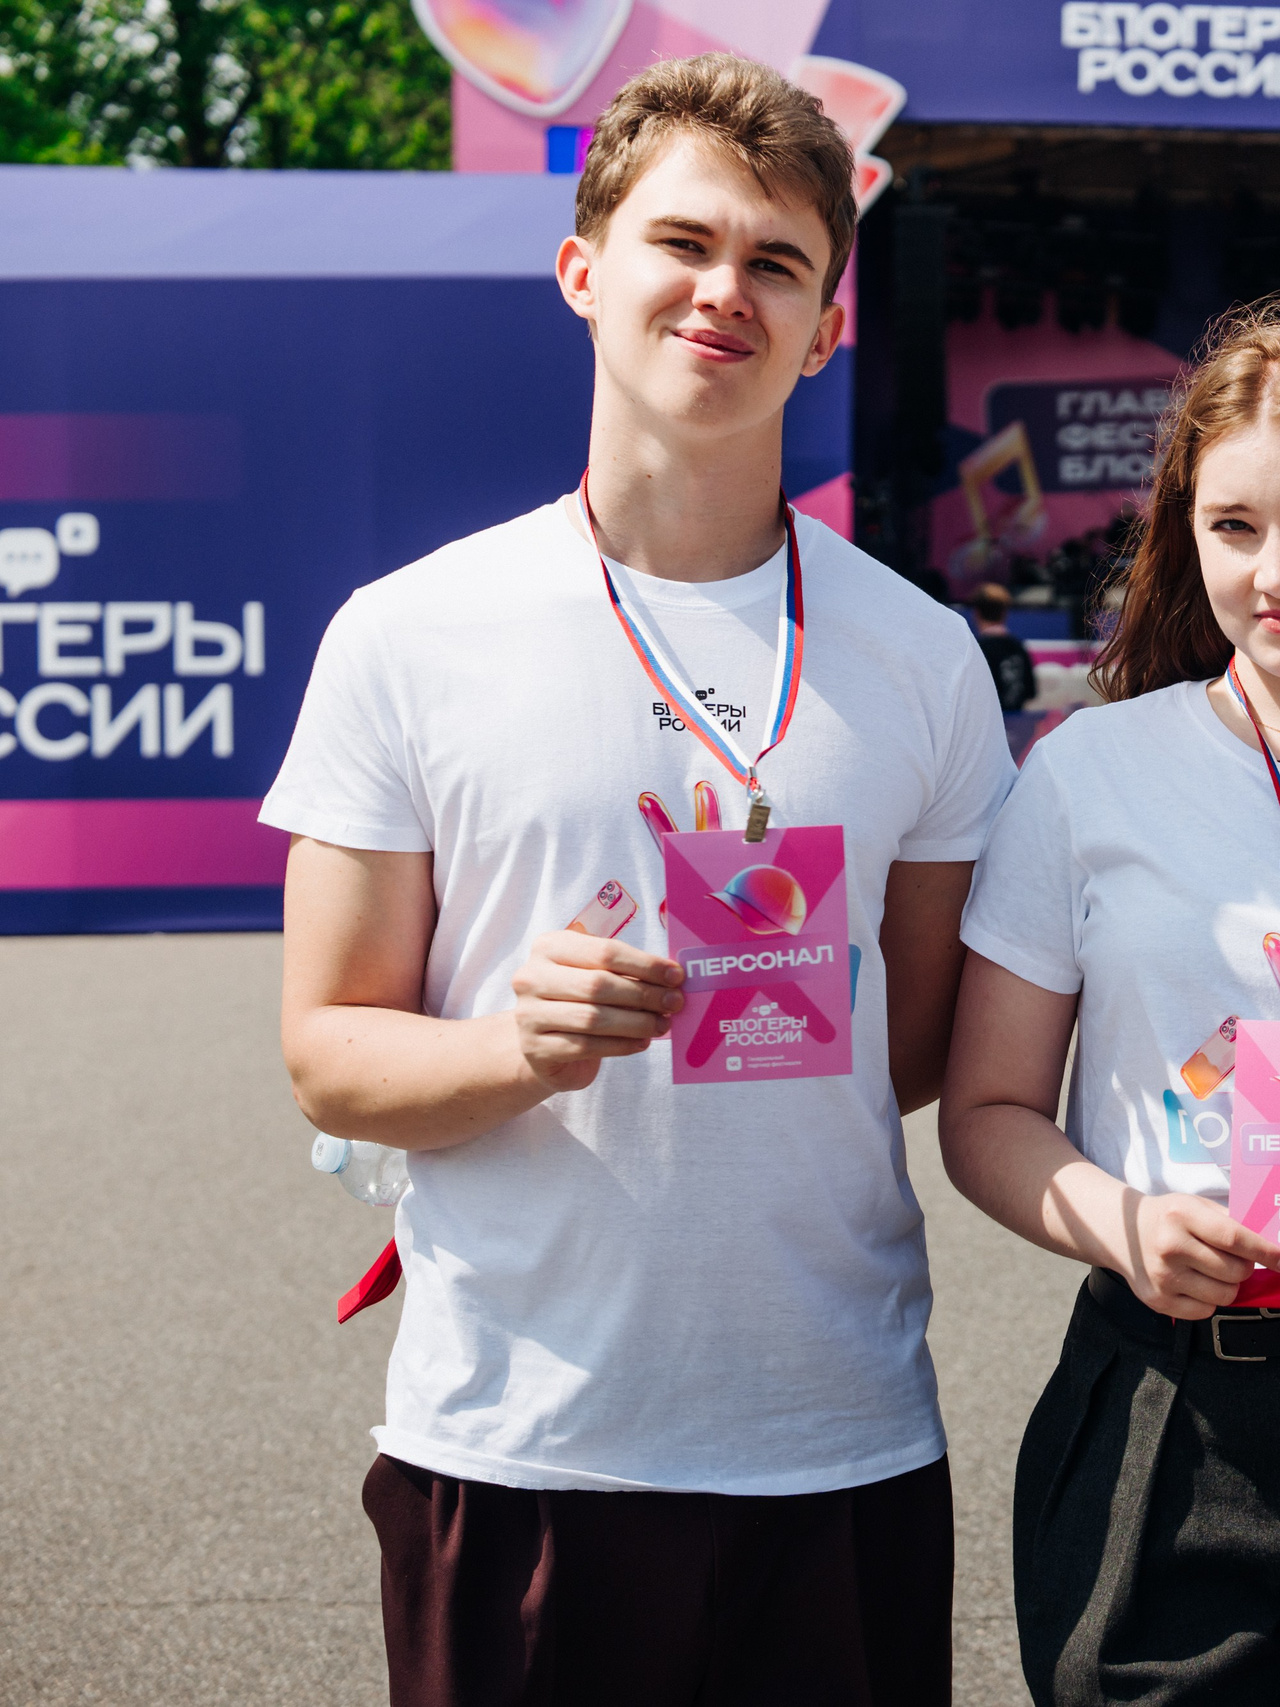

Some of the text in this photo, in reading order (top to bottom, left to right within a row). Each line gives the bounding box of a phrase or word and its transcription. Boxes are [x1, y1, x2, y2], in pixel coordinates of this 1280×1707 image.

[686, 945, 834, 978] ПЕРСОНАЛ
[719, 1016, 808, 1034] БЛОГЕРЫ
[725, 1030, 803, 1047] РОССИИ
